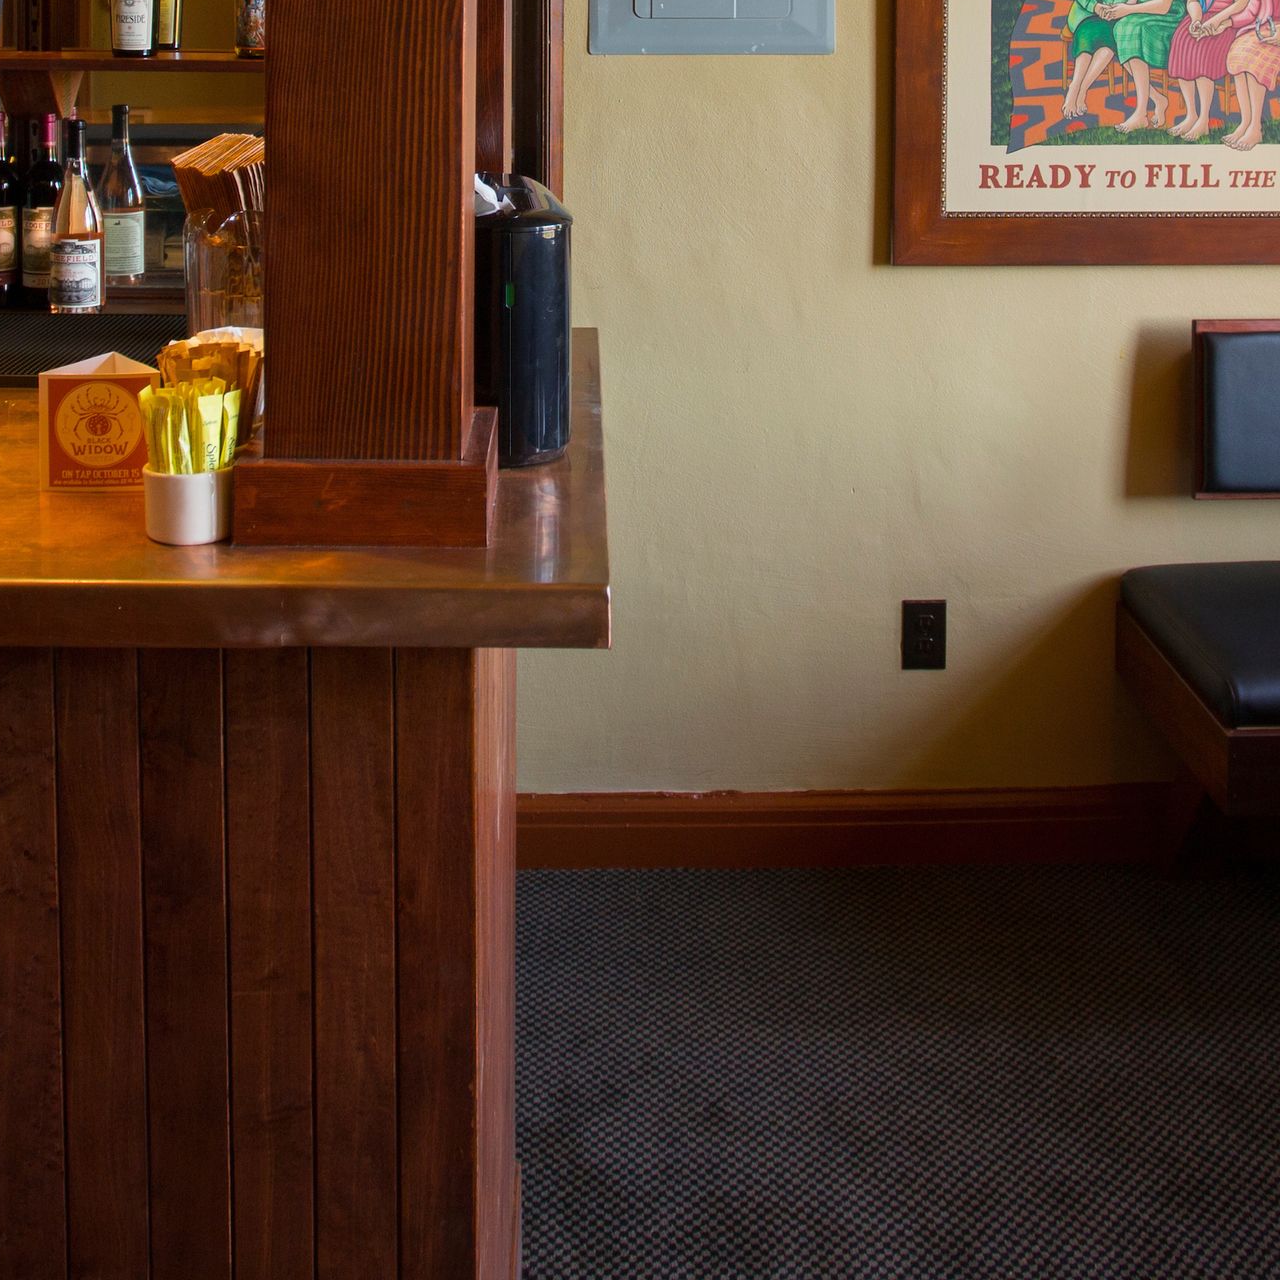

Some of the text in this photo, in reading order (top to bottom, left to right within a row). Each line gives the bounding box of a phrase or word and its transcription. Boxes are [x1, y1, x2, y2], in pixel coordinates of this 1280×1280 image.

[978, 163, 1097, 189] READY
[1105, 170, 1137, 188] TO
[1145, 163, 1220, 188] FILL
[1228, 170, 1277, 188] THE
[70, 441, 128, 456] WIDOW
[61, 470, 73, 479] ON
[75, 469, 92, 479] TAP
